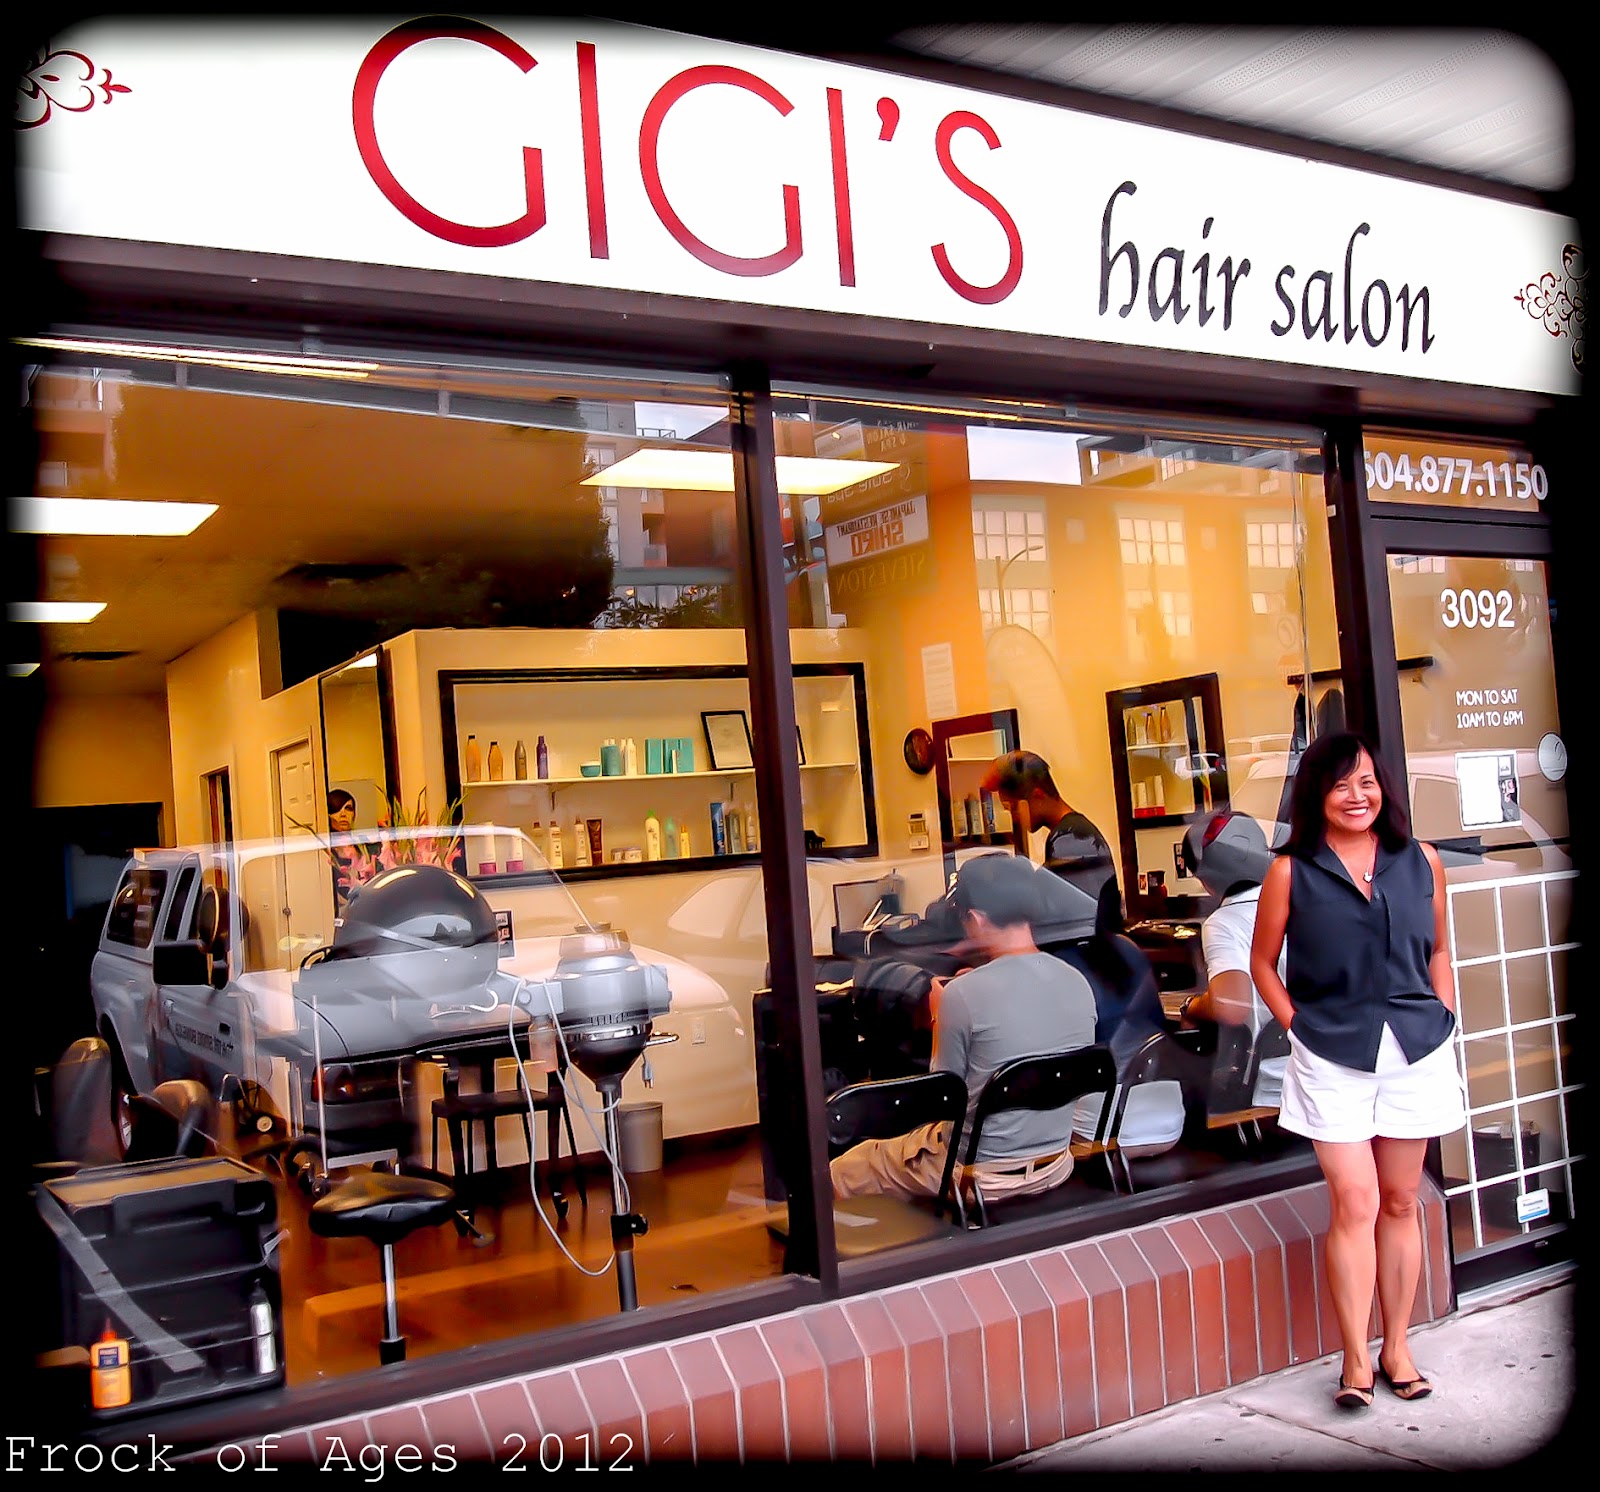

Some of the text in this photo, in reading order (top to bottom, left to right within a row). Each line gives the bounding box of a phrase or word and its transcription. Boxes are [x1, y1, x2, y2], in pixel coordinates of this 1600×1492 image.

[352, 14, 1436, 355] GIGI'S hair salon
[1440, 587, 1515, 629] 3092
[1456, 688, 1518, 706] MON TO SAT
[1456, 710, 1524, 729] 10AM TO 6PM
